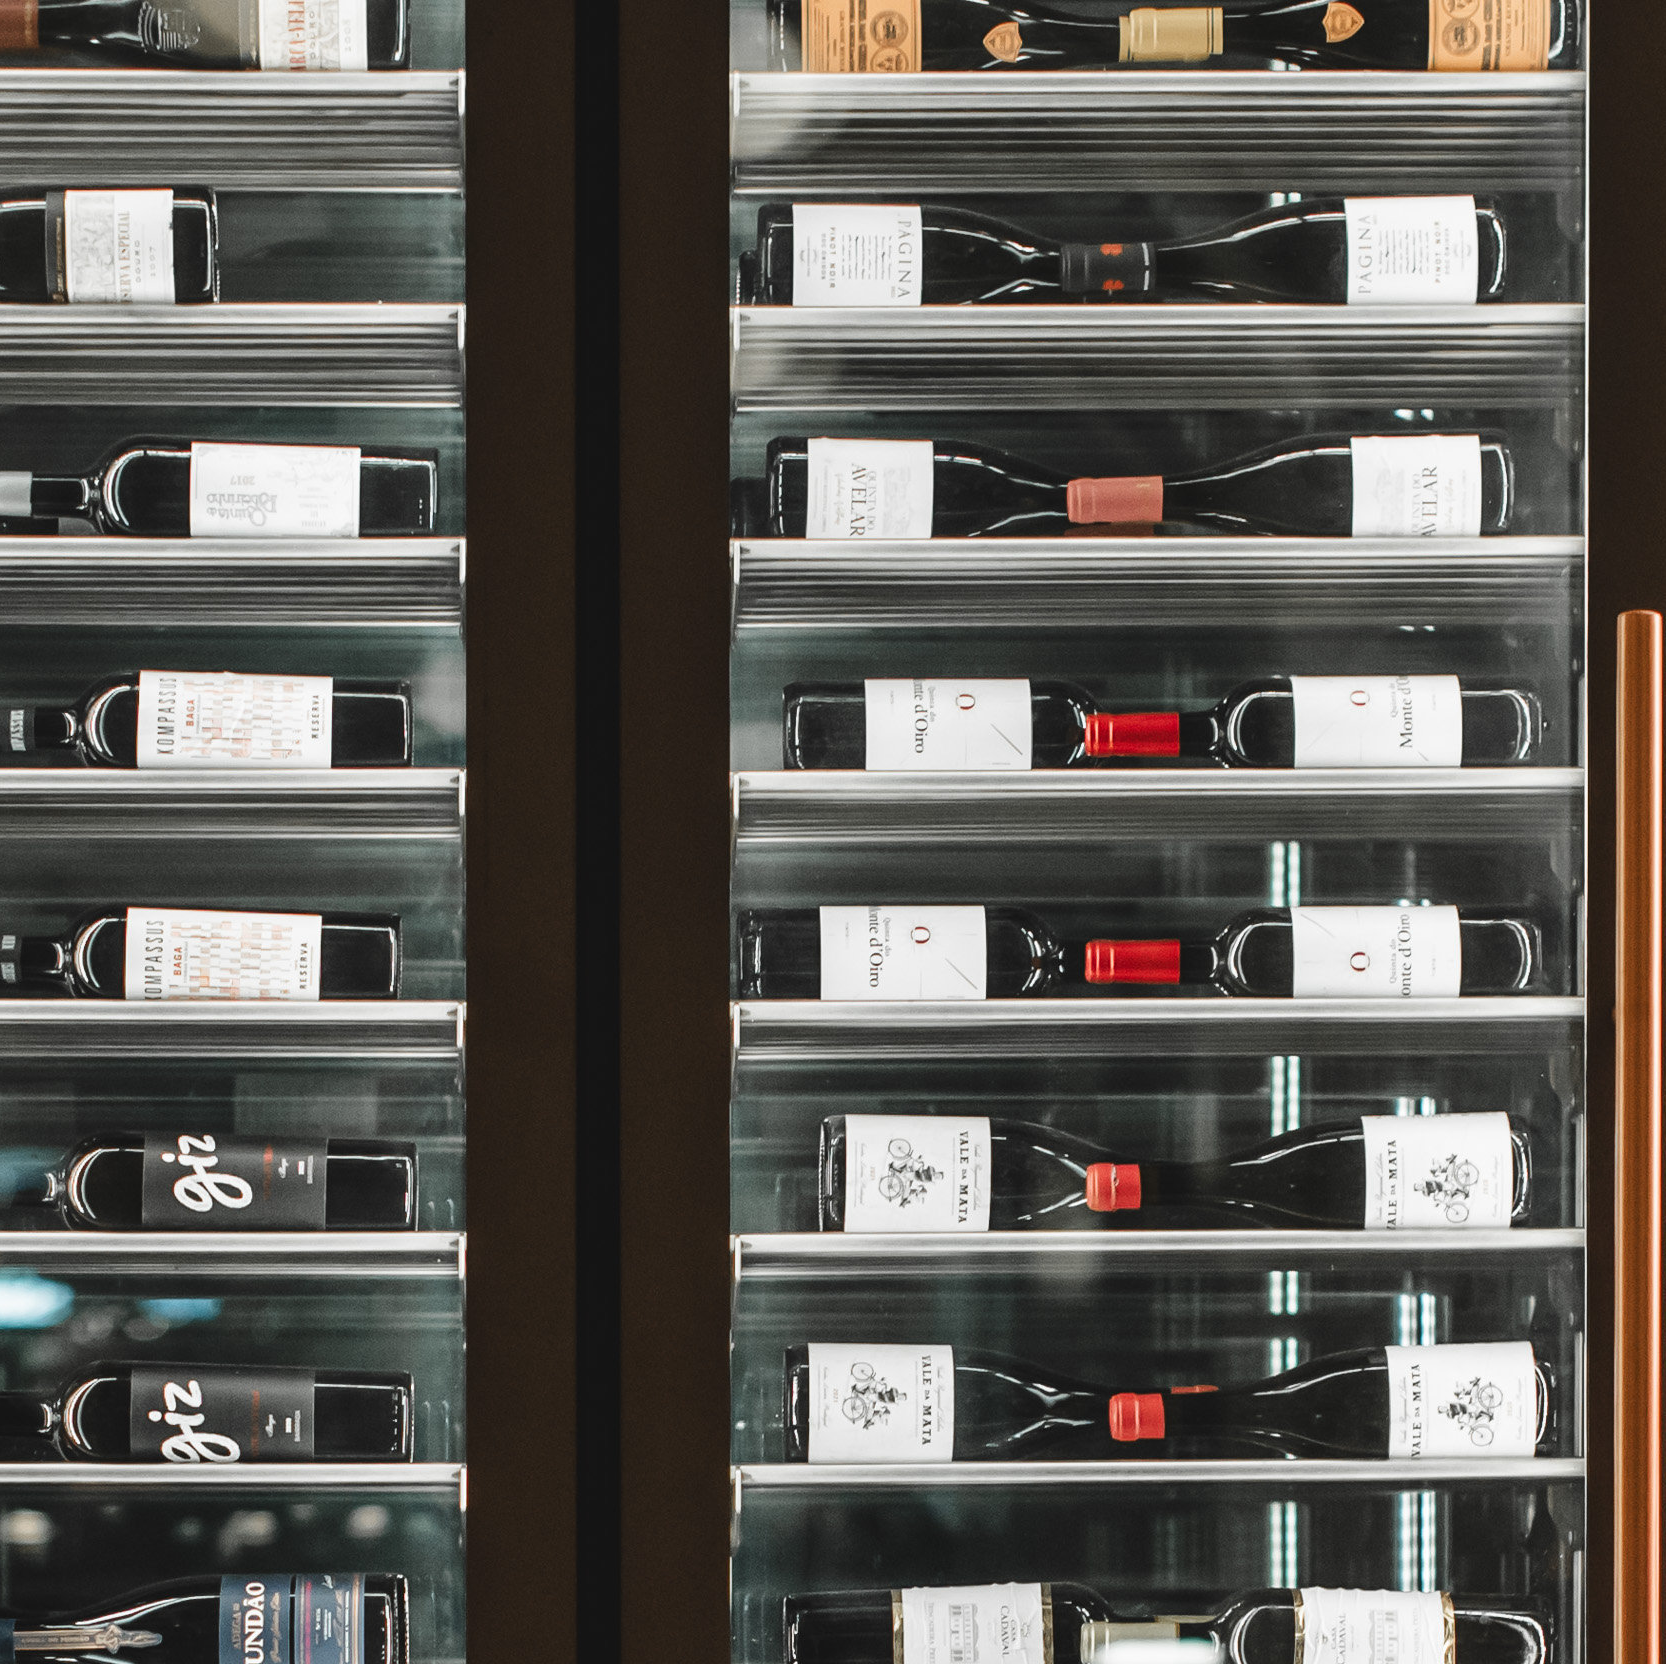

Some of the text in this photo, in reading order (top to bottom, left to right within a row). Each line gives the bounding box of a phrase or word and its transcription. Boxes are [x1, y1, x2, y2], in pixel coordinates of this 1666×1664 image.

[117, 212, 131, 261] ESPECIAL
[897, 220, 913, 298] PÁGINA
[1355, 215, 1373, 294] PÁGINA
[1434, 251, 1442, 283] PINOT
[230, 475, 255, 486] 2017
[849, 463, 867, 537] AVELAR
[866, 470, 877, 511] QUINTA
[218, 508, 267, 527] Quinta
[156, 678, 177, 755] KOMPASSUS
[185, 699, 195, 726] BAGA
[311, 695, 320, 739] RESERVA
[955, 693, 976, 710] O
[1399, 697, 1413, 748] Monte
[913, 709, 928, 754] d'Oiro
[910, 926, 931, 945] O
[1398, 913, 1411, 957] d'Oiro
[173, 946, 182, 976] BAGA
[299, 942, 308, 989] RESERVA
[869, 938, 883, 988] d'Oiro
[1349, 952, 1370, 971] O
[1389, 952, 1398, 984] Quinta
[161, 1134, 252, 1212] giz
[957, 1131, 969, 1223] VALE MATA
[1386, 1140, 1398, 1179] MATA
[148, 1380, 240, 1464] giz
[920, 1355, 933, 1446] VALE MATA
[1411, 1364, 1422, 1459] VALE MATA
[231, 1612, 242, 1650] ADEGA
[1000, 1605, 1010, 1658] CADAVAL
